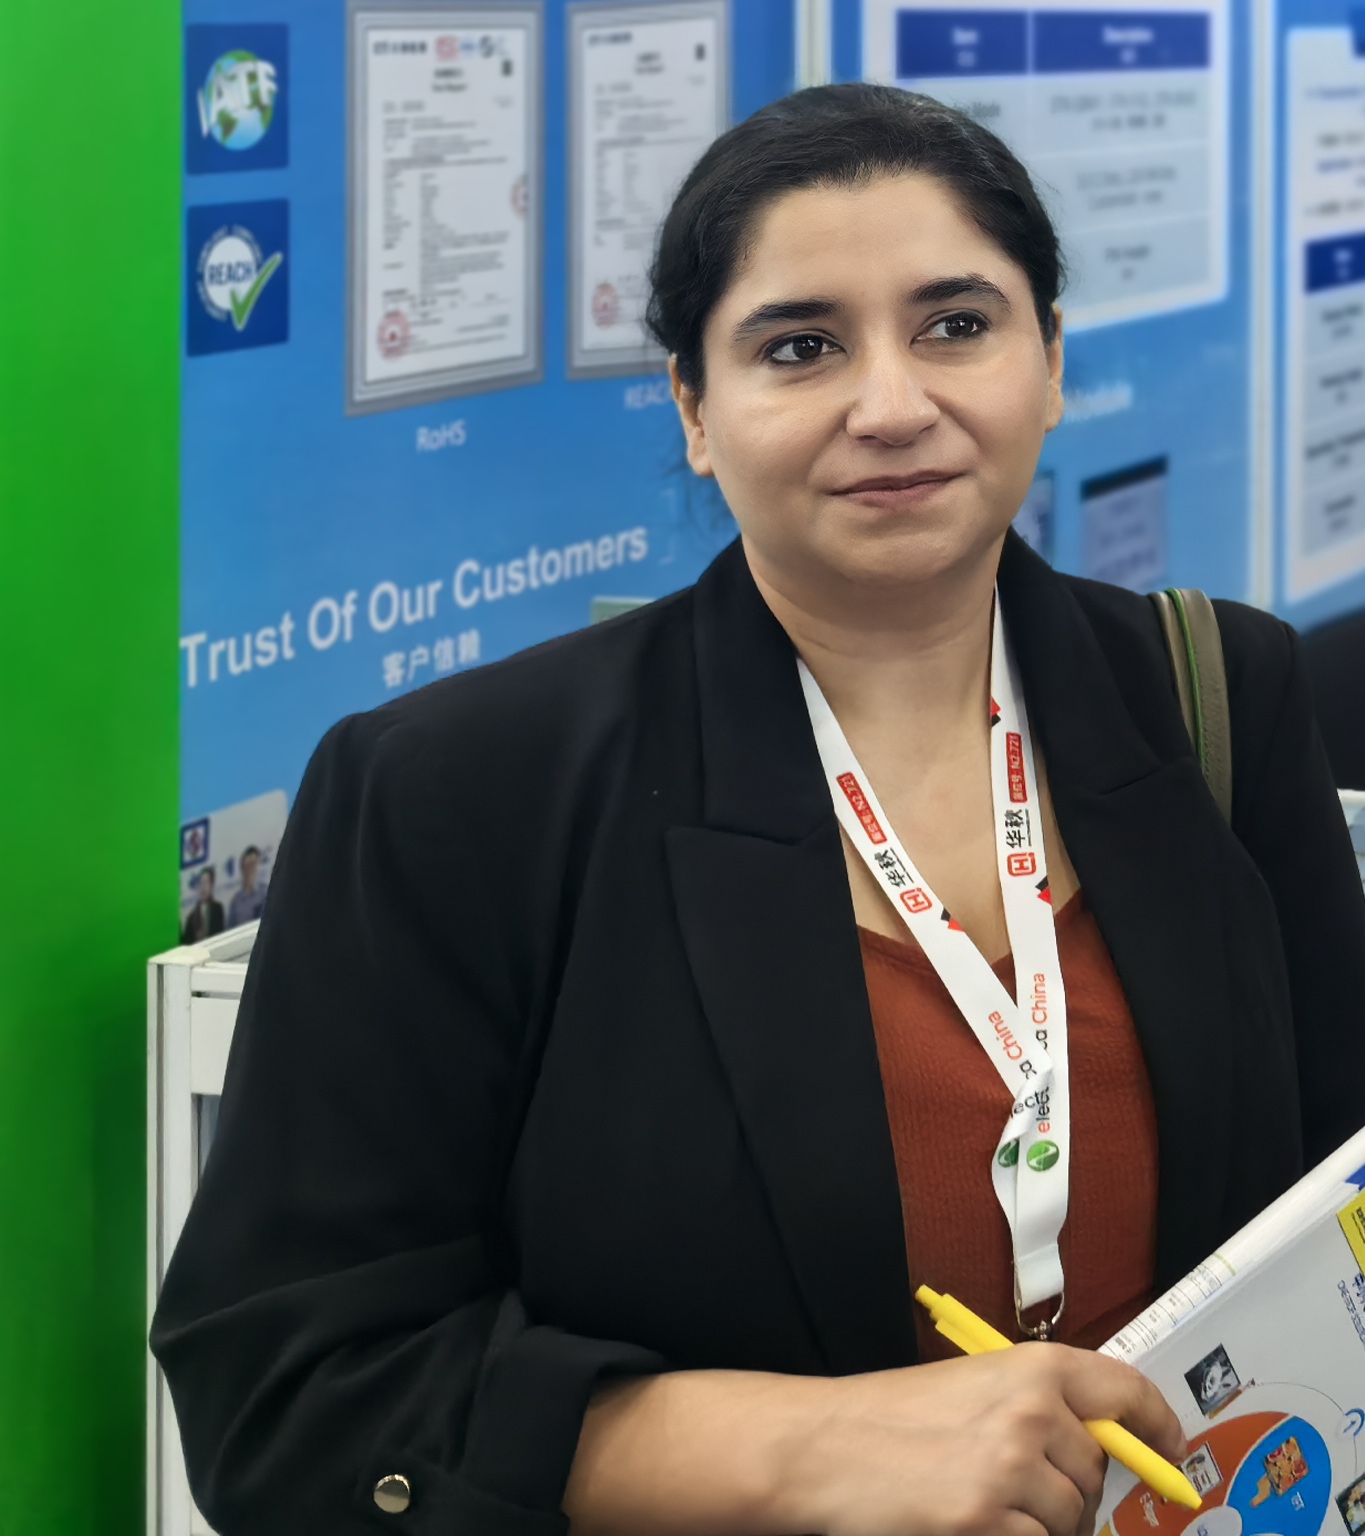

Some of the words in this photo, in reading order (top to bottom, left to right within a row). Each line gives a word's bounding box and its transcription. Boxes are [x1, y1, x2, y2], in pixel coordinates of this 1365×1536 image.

[624, 380, 672, 410] REAC
[416, 420, 467, 452] RoHS
[180, 612, 296, 688] Trust
[307, 590, 358, 652] Of
[368, 576, 443, 633] Our
[452, 525, 649, 610] Customers
[1029, 972, 1046, 1025] China
[986, 1010, 1024, 1062] China
